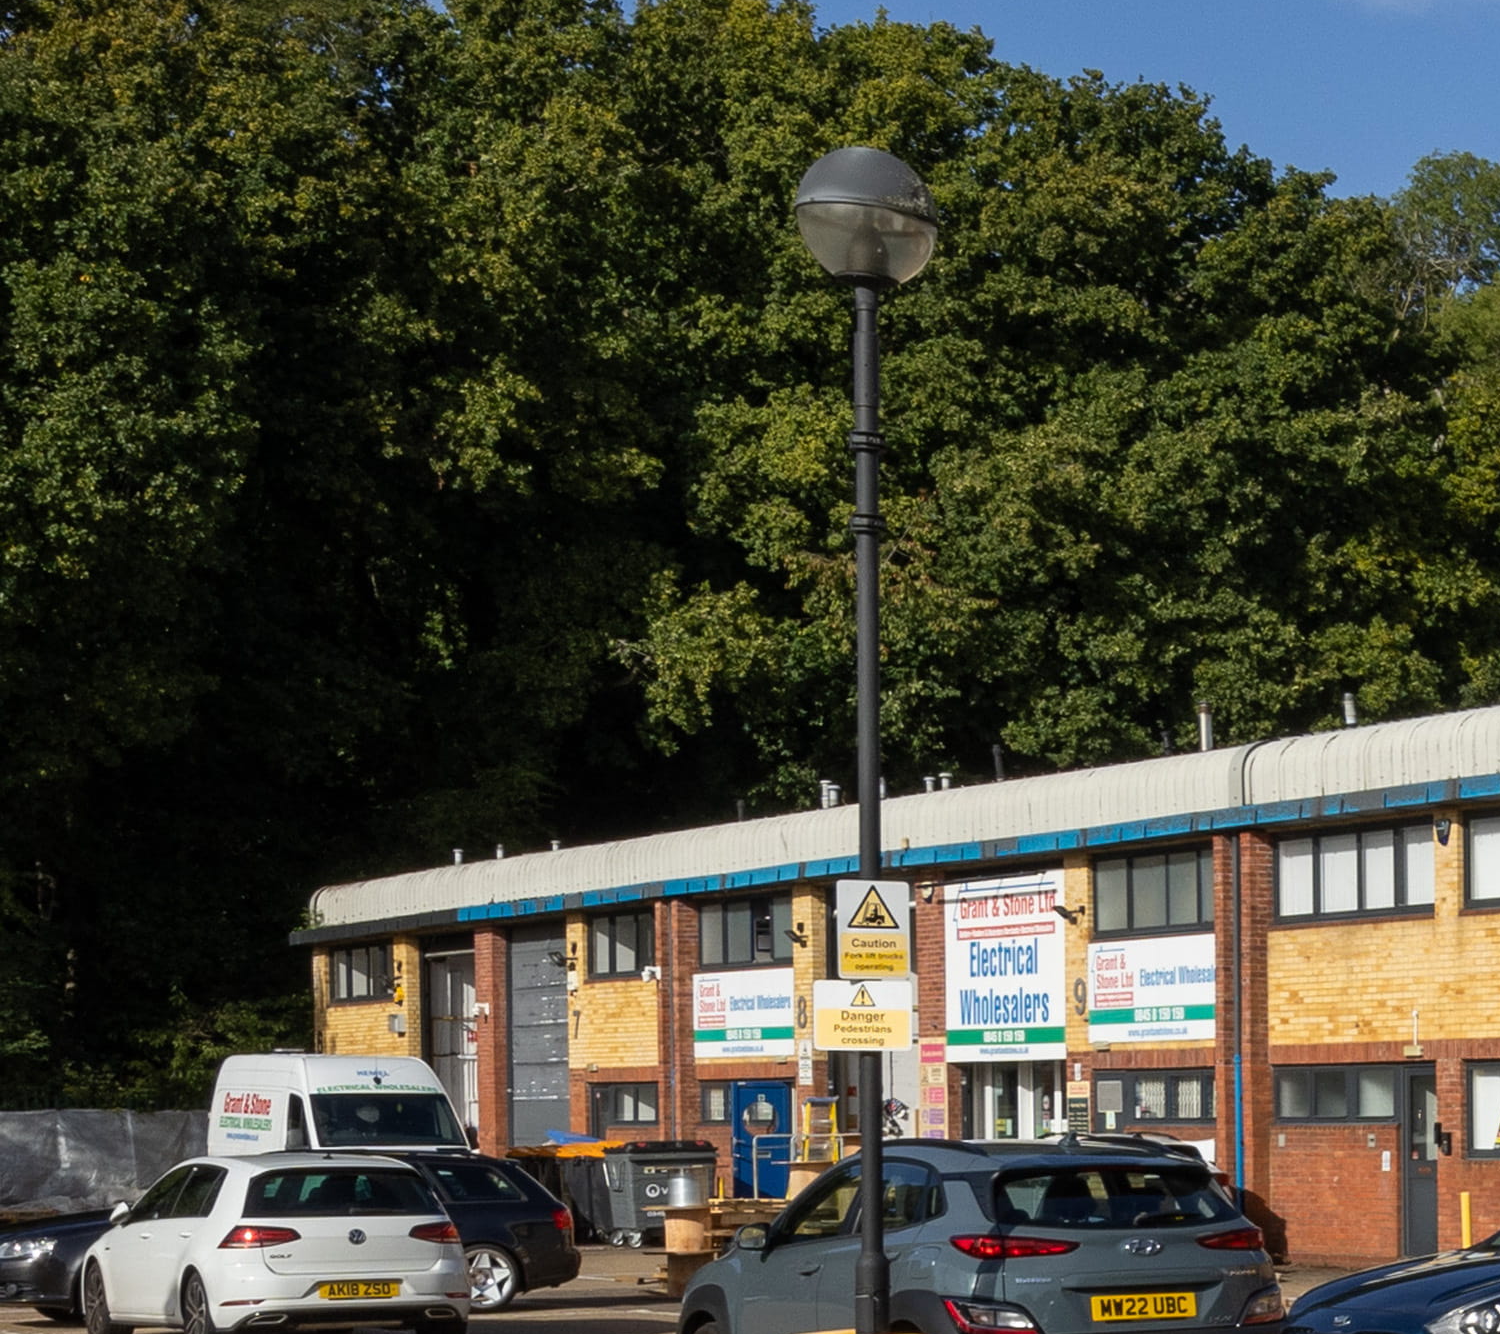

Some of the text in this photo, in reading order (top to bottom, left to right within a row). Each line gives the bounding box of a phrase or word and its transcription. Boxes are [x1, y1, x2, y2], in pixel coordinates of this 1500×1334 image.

[961, 890, 1055, 919] Grant & Stone Ltd
[851, 938, 896, 948] Caution
[970, 937, 1038, 977] Electrical
[1096, 953, 1126, 971] Grant &
[1096, 972, 1134, 989] Stone Ltd
[1140, 967, 1176, 987] Electrical
[700, 983, 720, 997] Grant &
[1073, 977, 1087, 1016] 9
[700, 999, 726, 1012] Stone Ltd
[730, 994, 791, 1011] Electrical Wholesalers
[960, 987, 1049, 1025] Wholesalers
[797, 995, 807, 1029] 8
[841, 1011, 885, 1023] Danger
[573, 1010, 580, 1039] 7
[834, 1023, 892, 1034] Pedestrians
[841, 1036, 885, 1046] crossing
[317, 1084, 439, 1094] ELECTRICAL WHOLESALERS
[224, 1091, 272, 1115] Grant & Stone
[328, 1283, 391, 1297] AK18 ZSO
[1100, 1296, 1188, 1317] MW22 UBC
